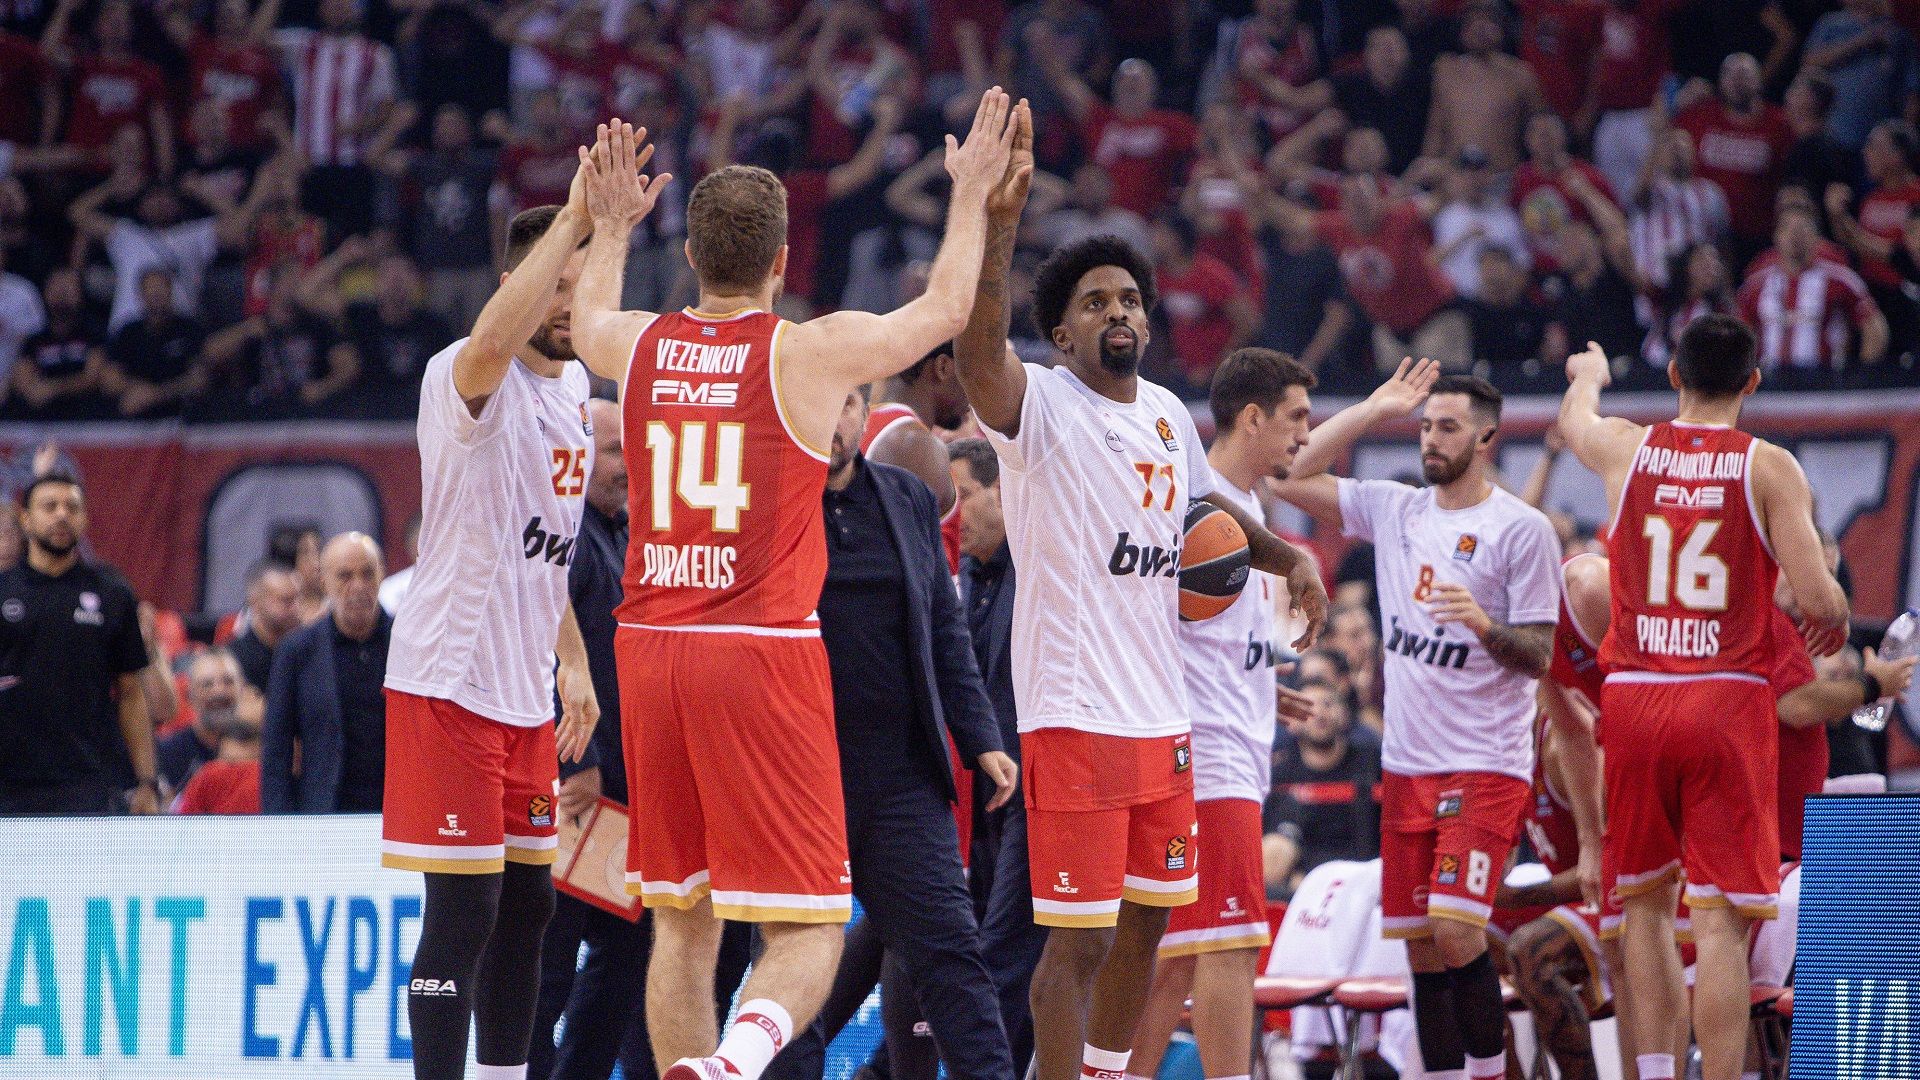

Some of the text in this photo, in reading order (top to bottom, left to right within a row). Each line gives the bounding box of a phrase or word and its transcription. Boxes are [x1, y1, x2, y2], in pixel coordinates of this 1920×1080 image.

[656, 338, 750, 374] VEZENKOV
[651, 379, 739, 404] FMS
[552, 448, 586, 496] 25
[645, 420, 751, 533] 14
[1637, 445, 1745, 480] PAPANIKOLAOU
[1134, 462, 1175, 512] 77
[1654, 483, 1725, 508] FMS
[639, 542, 737, 590] PIRAEUS
[1412, 563, 1434, 602] 8
[1642, 514, 1730, 613] 16
[1636, 614, 1720, 658] PIRAEUS
[1465, 850, 1492, 896] 8
[0, 897, 206, 1058] ANT
[410, 978, 458, 993] GSA
